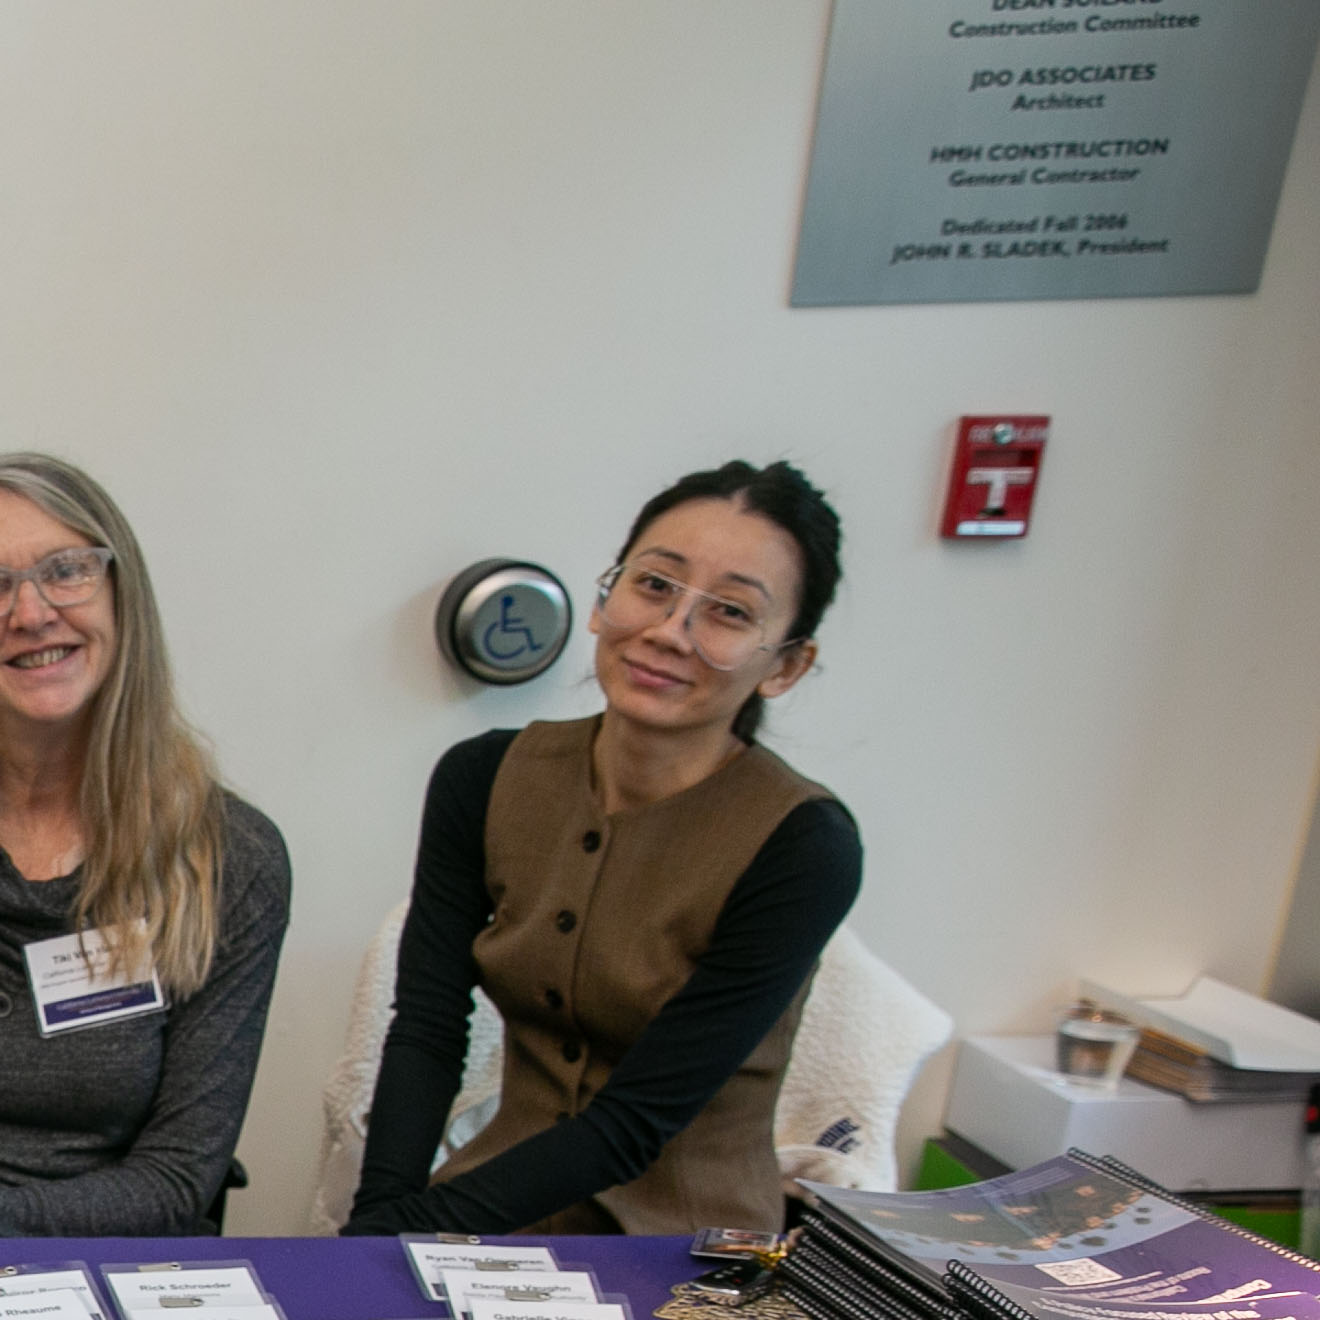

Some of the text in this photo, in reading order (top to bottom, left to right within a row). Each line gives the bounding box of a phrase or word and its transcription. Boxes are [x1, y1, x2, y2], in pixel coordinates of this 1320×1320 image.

[949, 11, 1200, 38] Construction Committee
[969, 64, 1157, 91] JDO ASSOCIATES
[1011, 94, 1105, 112] Architect
[930, 139, 1169, 163] HMH CONSTRUCTION
[949, 167, 1139, 187] General Contractor
[941, 214, 1127, 236] Dedicated Fall 2006
[891, 245, 950, 266] JOHN
[957, 244, 977, 259] R.
[1077, 238, 1168, 255] President
